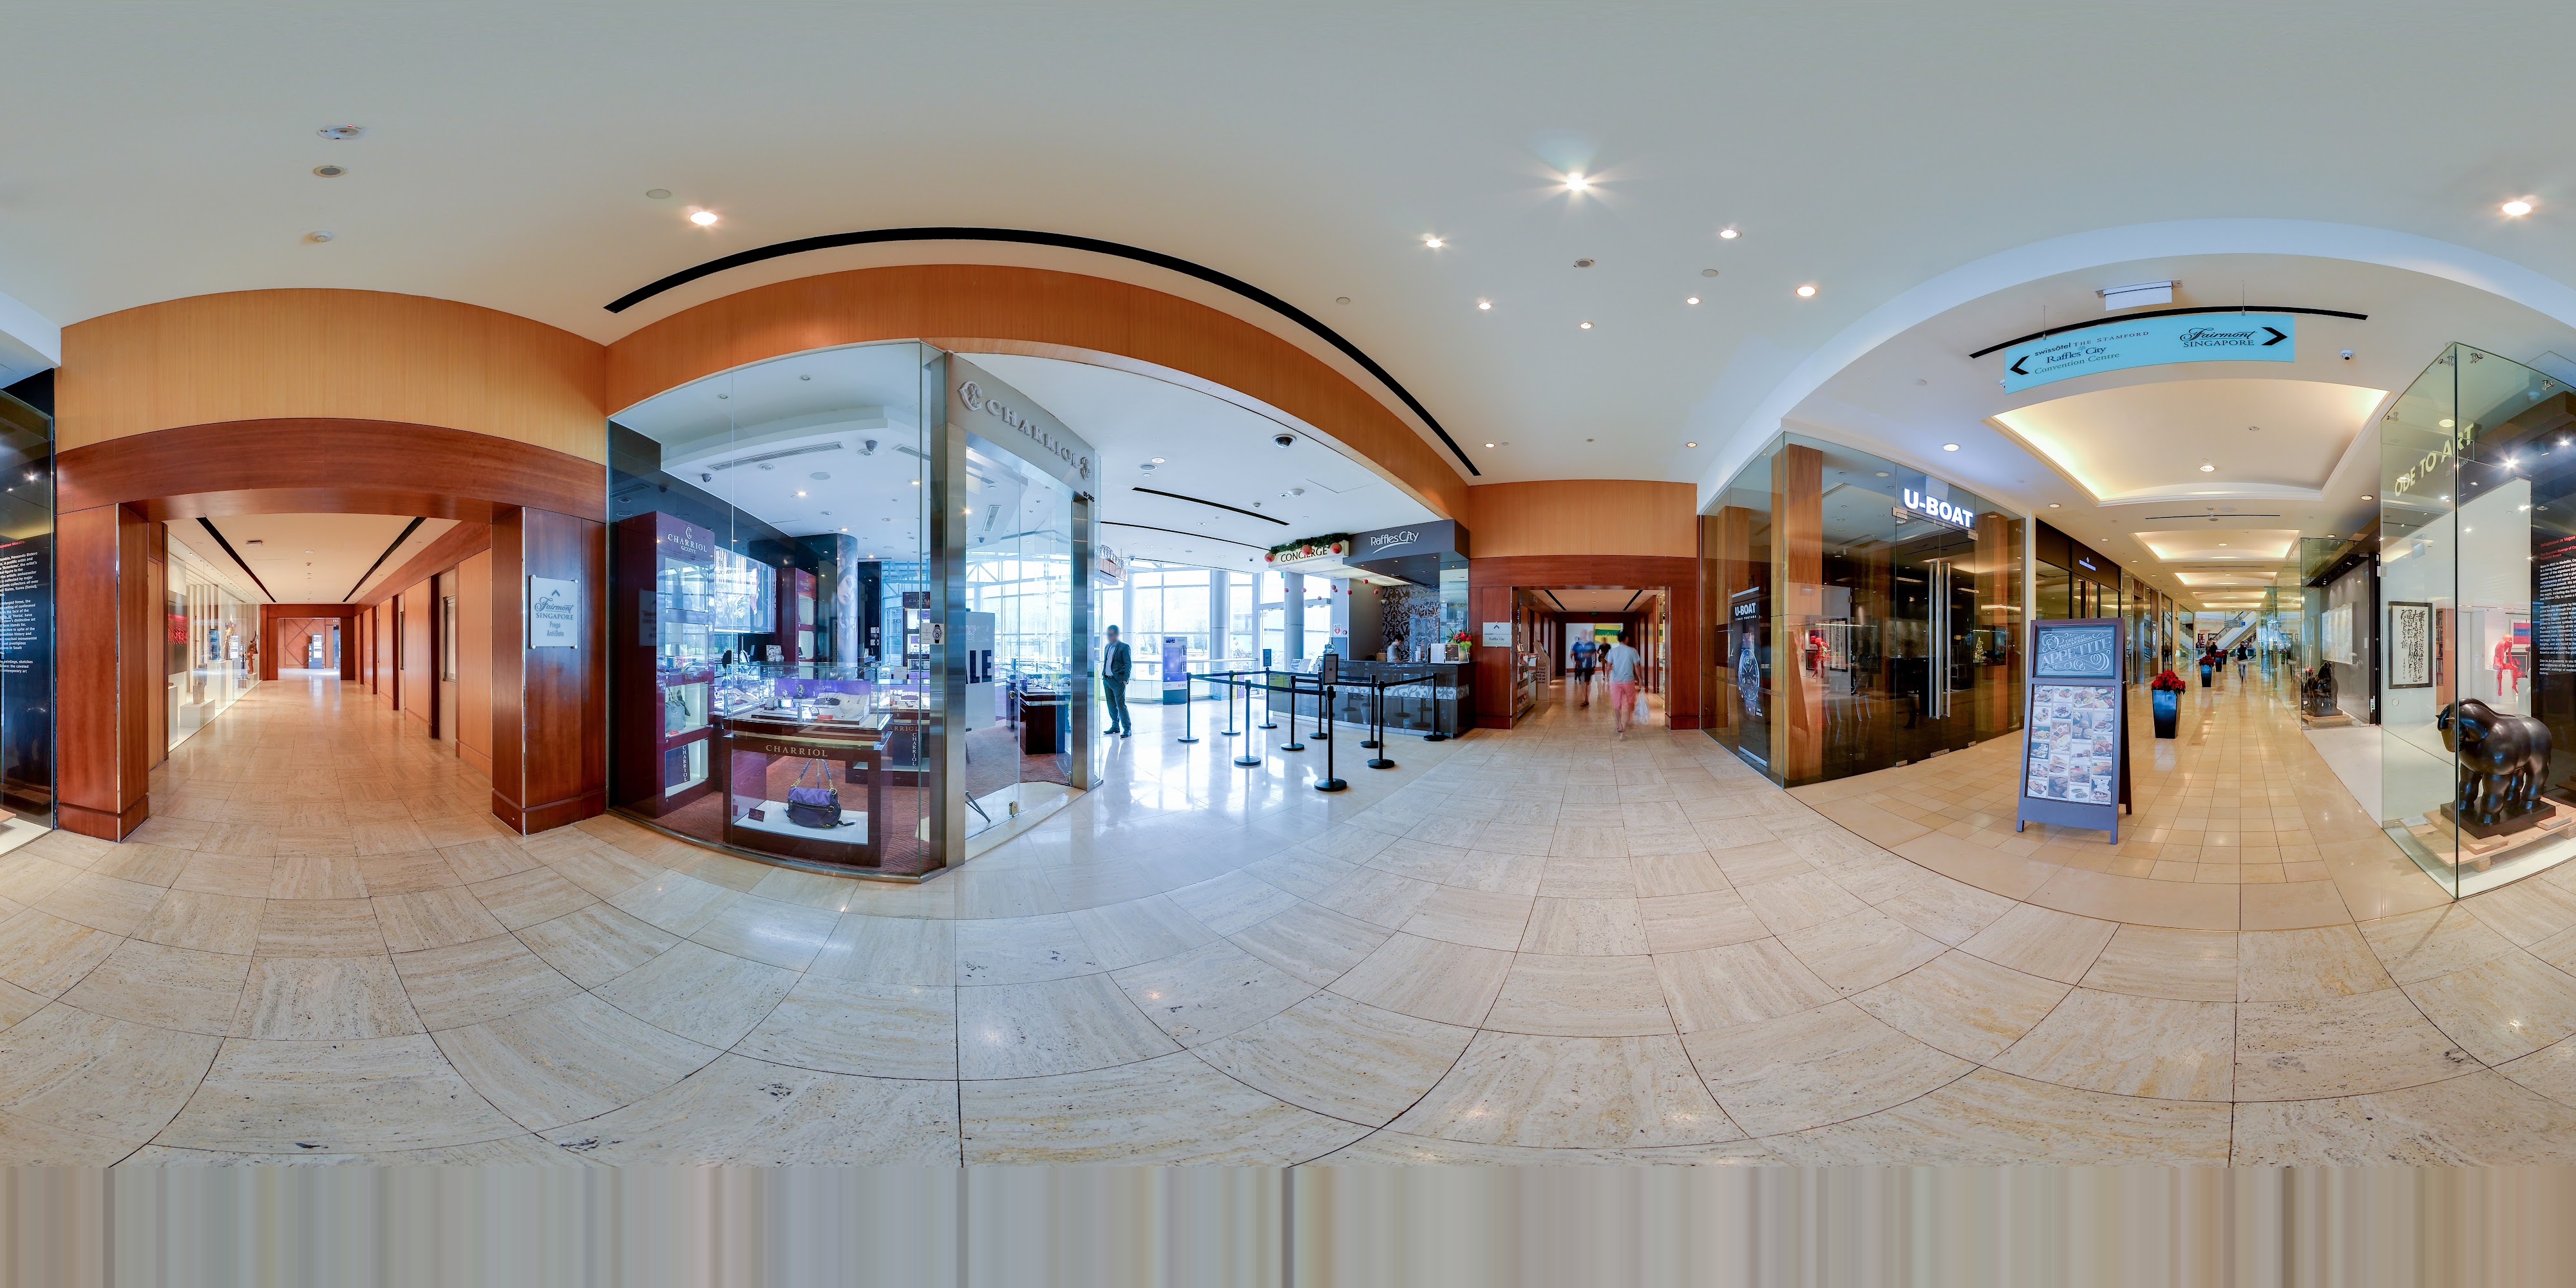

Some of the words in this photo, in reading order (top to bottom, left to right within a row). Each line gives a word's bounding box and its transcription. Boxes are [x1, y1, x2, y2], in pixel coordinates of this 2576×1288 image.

[2180, 327, 2258, 341] Fairmont
[2034, 343, 2071, 356] swissôtel
[2097, 331, 2149, 343] STAMFORD
[2034, 359, 2085, 374] Convention
[2088, 353, 2120, 363] Centre
[2046, 351, 2081, 364] Raffles
[2085, 346, 2107, 355] City
[986, 399, 1080, 469] CHARRIOL
[2395, 466, 2416, 497] ODE
[2420, 450, 2437, 478] TO
[2441, 422, 2474, 464] ART
[1904, 488, 1973, 528] U-BOAT
[667, 533, 707, 553] CHARRIOL
[1370, 533, 1398, 546] Raffles
[1399, 531, 1419, 542] City
[1280, 546, 1327, 562] CONCRGE
[535, 596, 574, 614] Fairmont
[1735, 602, 1756, 616] U-BOAT
[2065, 634, 2085, 643] DELIGHT
[2071, 636, 2093, 645] MORNING
[2040, 636, 2112, 669] APPETITE
[966, 650, 992, 684] LE
[766, 744, 828, 757] CHARRIOL
